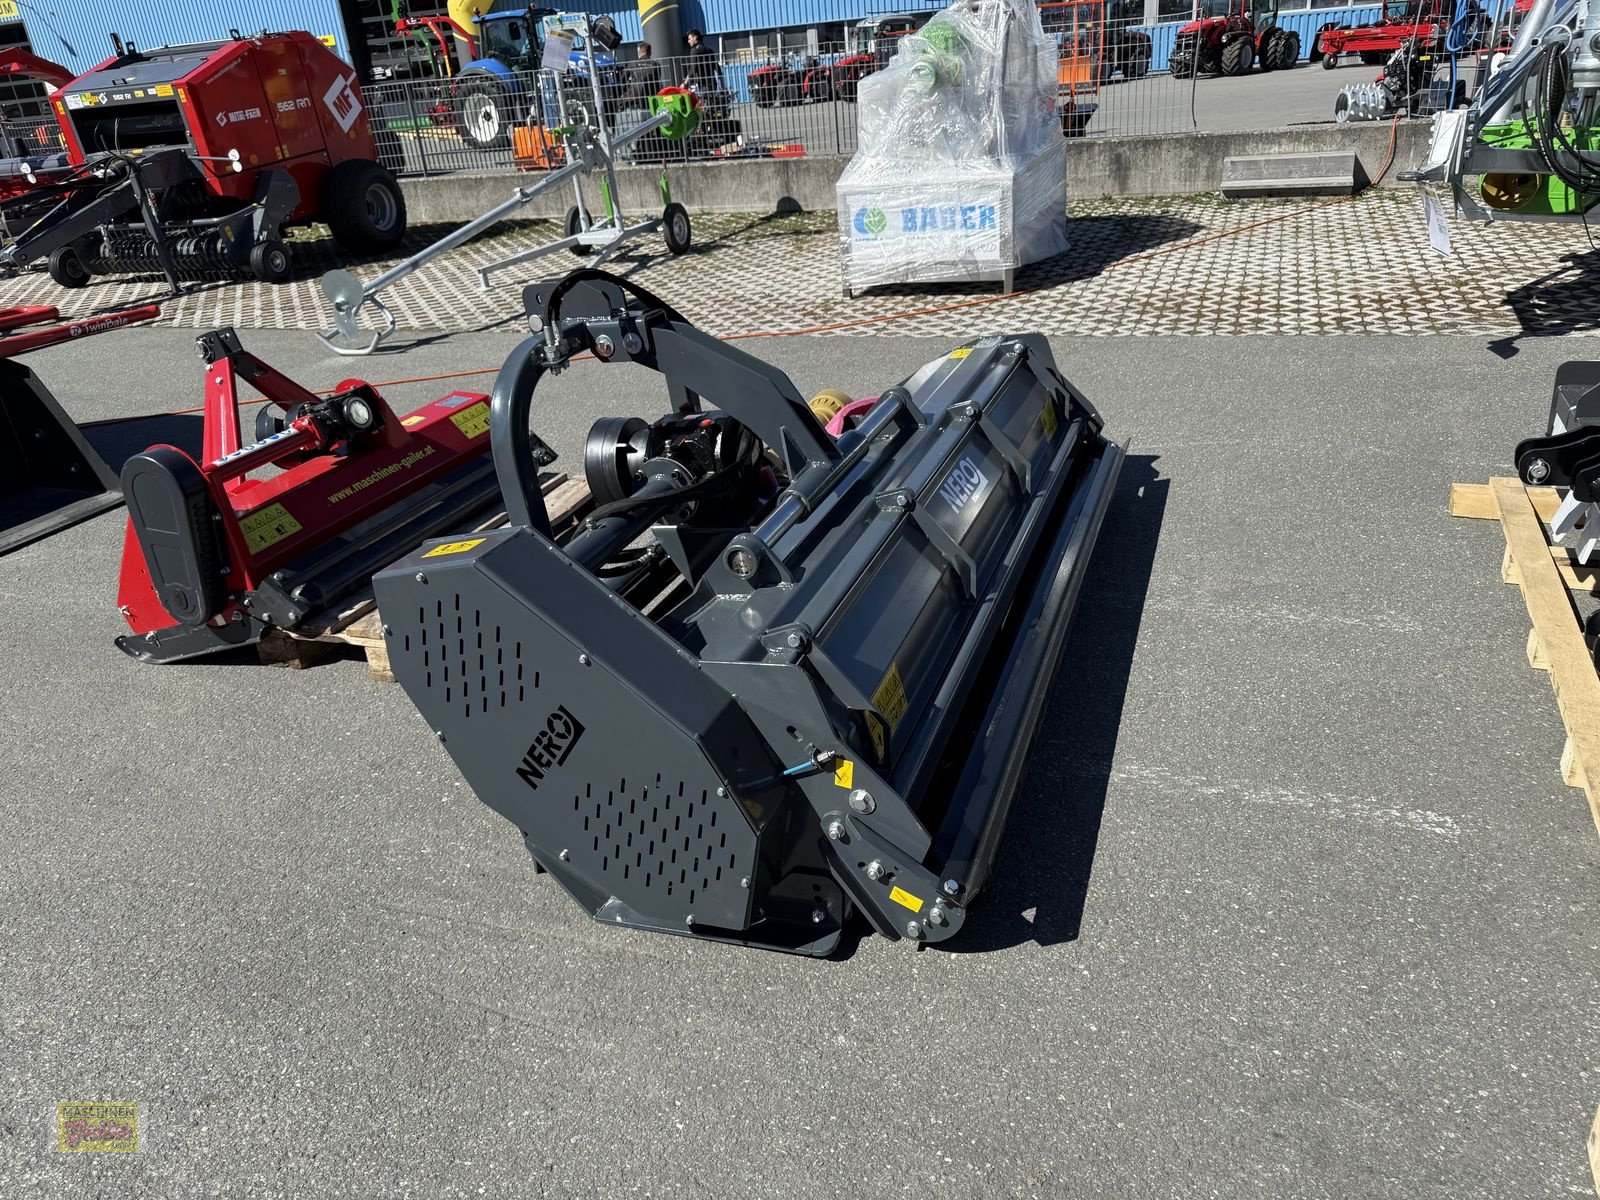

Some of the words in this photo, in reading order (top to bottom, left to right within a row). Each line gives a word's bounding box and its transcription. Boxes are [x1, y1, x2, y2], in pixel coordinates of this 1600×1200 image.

[277, 100, 295, 112] 562
[902, 205, 996, 232] BAUER
[82, 316, 128, 333] TwinBale
[328, 445, 435, 504] www.maschinen-gailer.at
[939, 459, 979, 514] NERO
[516, 712, 572, 790] NERO
